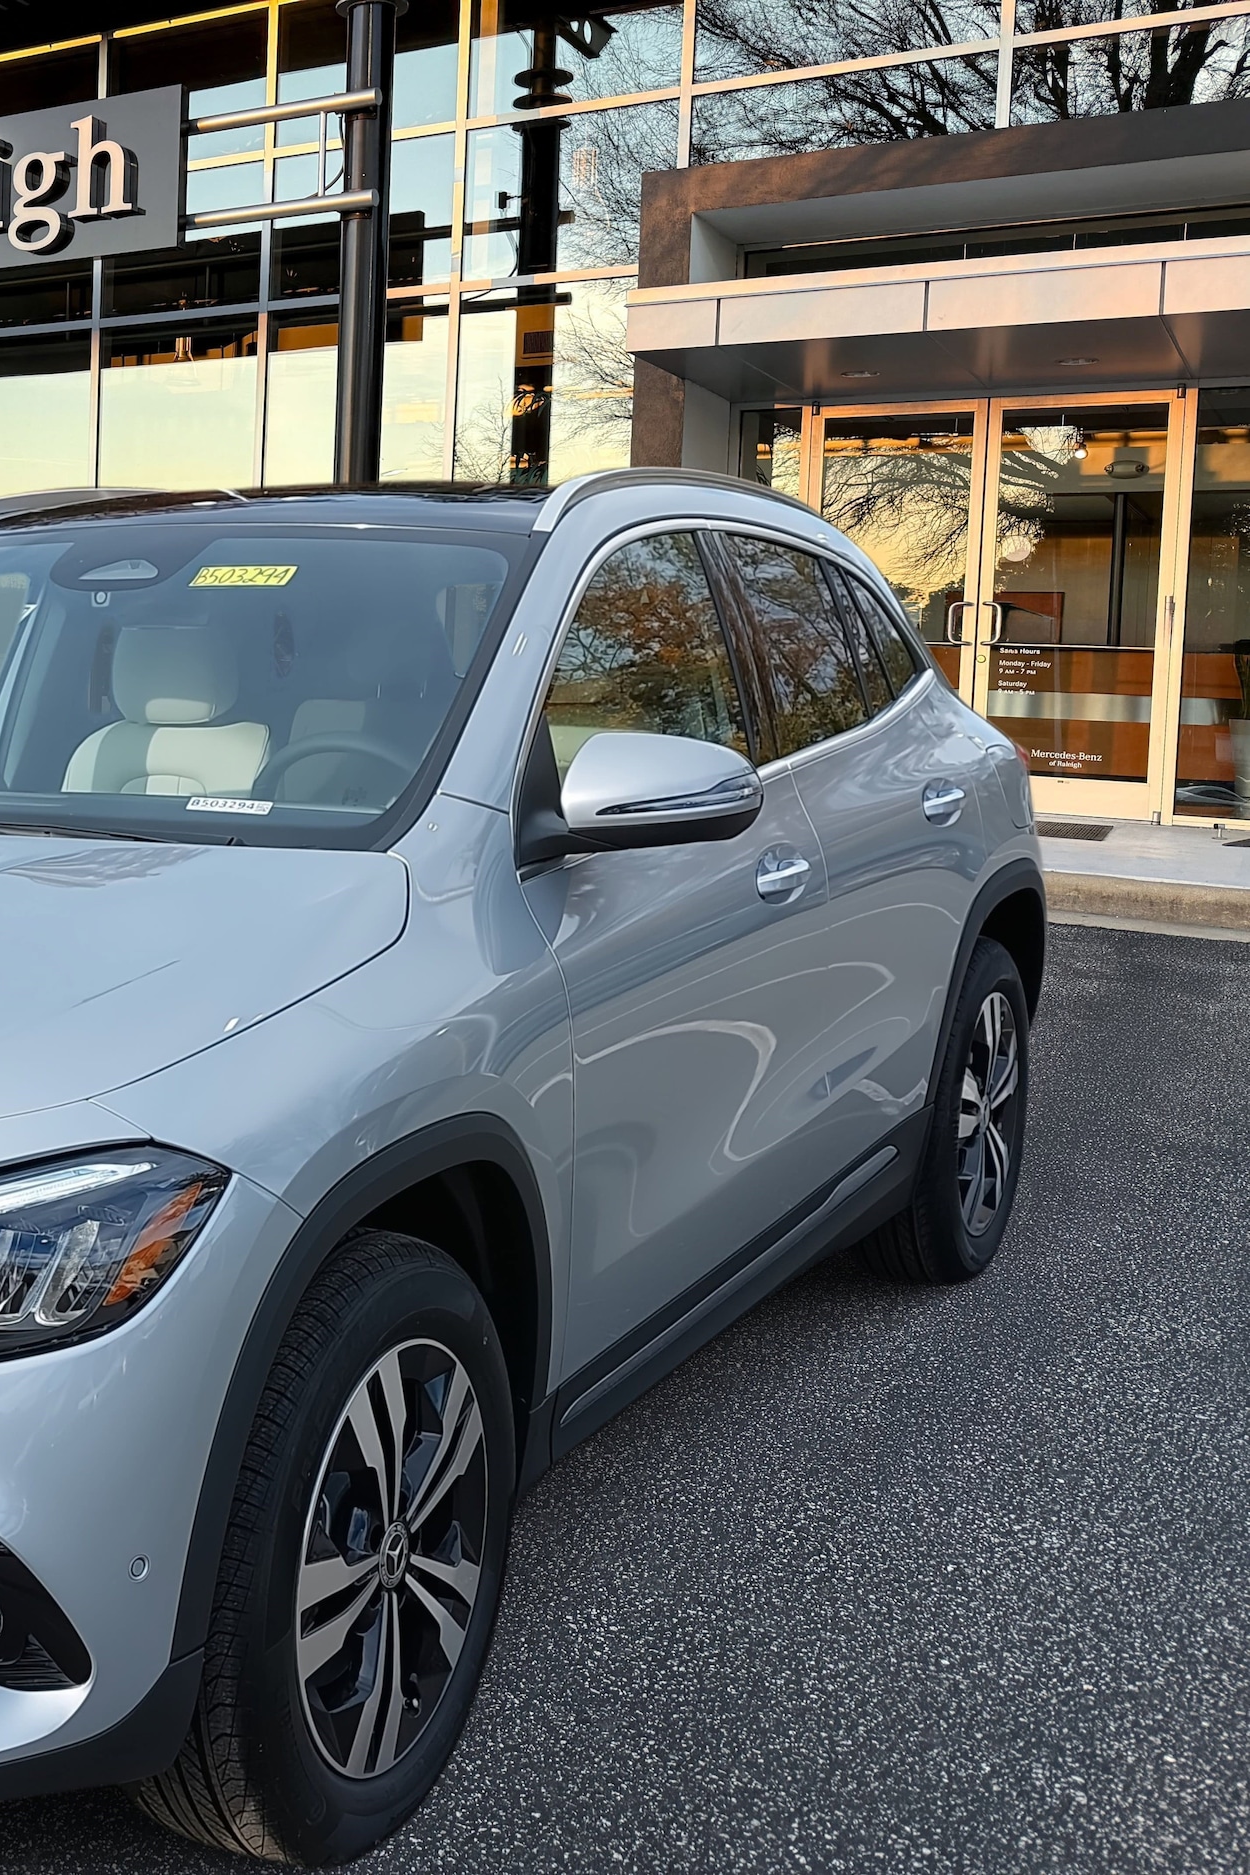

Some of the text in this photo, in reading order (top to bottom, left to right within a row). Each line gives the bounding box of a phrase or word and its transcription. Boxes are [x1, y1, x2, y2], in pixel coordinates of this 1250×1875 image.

[193, 567, 292, 585] B503294
[998, 660, 1026, 668] Monday
[1030, 660, 1052, 669] Friday
[997, 680, 1028, 689] Saturday
[1030, 749, 1103, 762] Mercedes-Benz
[1057, 760, 1083, 769] Raleigh
